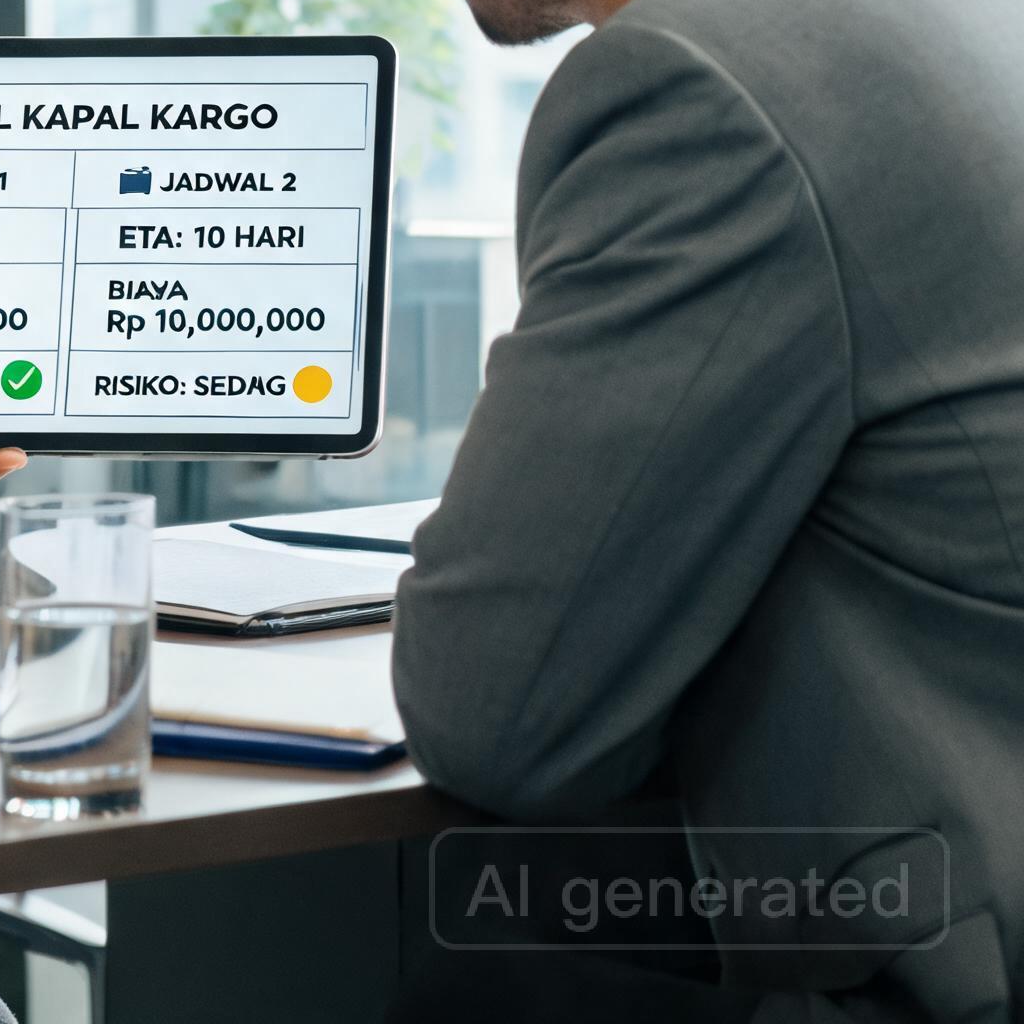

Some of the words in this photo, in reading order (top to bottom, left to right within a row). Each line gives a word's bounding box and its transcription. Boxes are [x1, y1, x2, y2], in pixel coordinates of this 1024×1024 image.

[23, 104, 139, 130] KAPAL
[151, 103, 278, 130] KARGO
[0, 172, 7, 190] 1
[160, 173, 273, 192] JADWAL
[282, 173, 296, 191] 2
[120, 226, 182, 249] ETA:
[195, 226, 225, 248] 10
[236, 226, 304, 248] HARI
[108, 310, 145, 340] Rp
[155, 308, 325, 338] 10,000,000
[95, 375, 185, 396] RISIKO:
